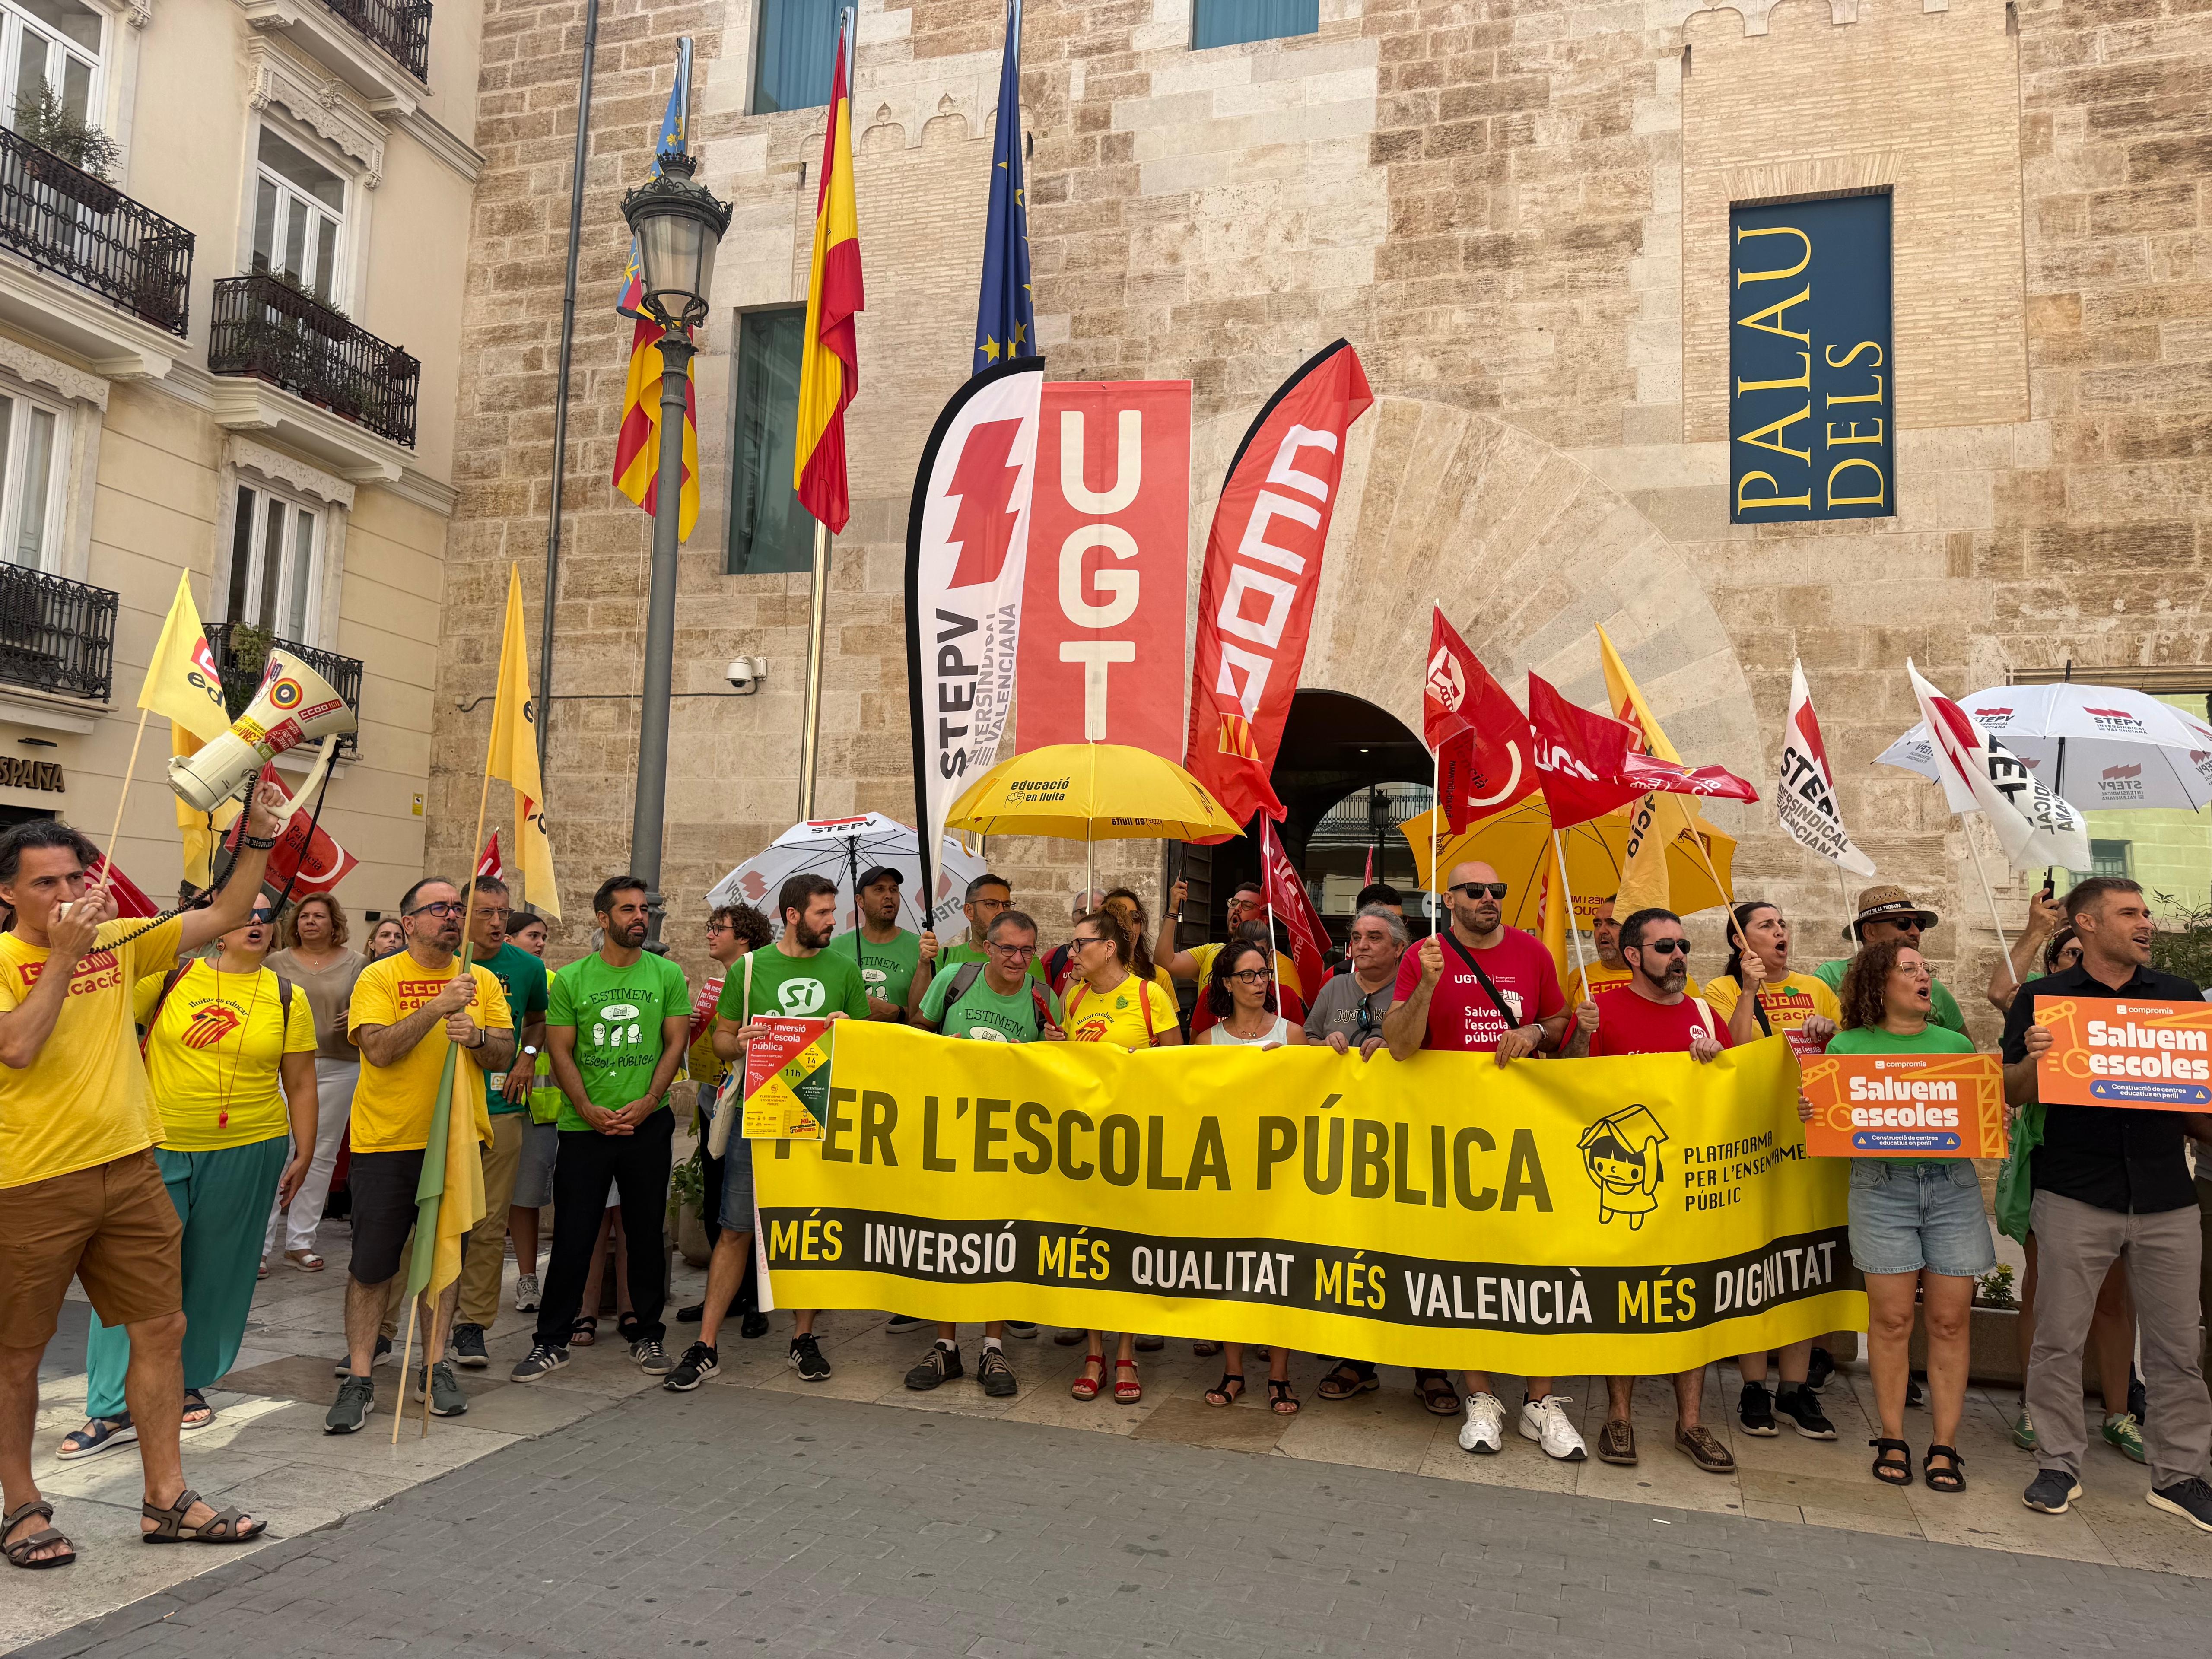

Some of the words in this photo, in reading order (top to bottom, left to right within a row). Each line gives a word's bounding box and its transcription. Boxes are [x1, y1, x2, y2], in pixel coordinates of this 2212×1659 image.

[1737, 226, 1812, 516] PALAU
[1825, 341, 1885, 511] DELS
[1059, 409, 1143, 740] UGT
[984, 603, 1016, 743] VALENCIANA
[936, 608, 978, 779] STEPV
[2094, 717, 2142, 727] STEPV
[1011, 777, 1070, 790] educació
[1039, 791, 1065, 801] lluita
[1781, 747, 1840, 826] STEP
[810, 820, 877, 834] STEPV
[188, 998, 214, 1008] lluitar
[226, 1000, 248, 1016] educar
[589, 988, 653, 1005] ESTIMEM
[774, 1023, 806, 1033] inversió
[965, 1009, 1024, 1037] ESTIMEM
[1465, 1019, 1509, 1030] l'escola
[2087, 1020, 2207, 1051] Salvem
[752, 1042, 783, 1051] pública
[769, 1032, 801, 1042] l'escola
[1465, 1031, 1503, 1044] públic
[785, 1069, 801, 1077] 11h
[2089, 1051, 2209, 1080] escoles
[1849, 1076, 1957, 1100] Salvem
[1851, 1102, 1959, 1127] escoles
[922, 1096, 1232, 1191] L'ESCOLA
[1256, 1093, 1554, 1213] PÚBLICA
[1684, 1130, 1773, 1164] PLATAFORMA
[1684, 1170, 1716, 1189] PER
[1723, 1143, 1811, 1183] L'ENSENYAME
[1684, 1186, 1741, 1212] PÚBLIC
[769, 1208, 843, 1261] MÉS
[864, 1221, 1017, 1274] INVERSIÓ
[1038, 1227, 1111, 1281] MÉS
[1132, 1246, 1295, 1297] QUALITAT
[1314, 1250, 1386, 1310] MÉS
[1405, 1268, 1592, 1325] VALENCIÀ
[1618, 1267, 1697, 1324] MÉS
[1715, 1241, 1836, 1313] DIGNITAT
